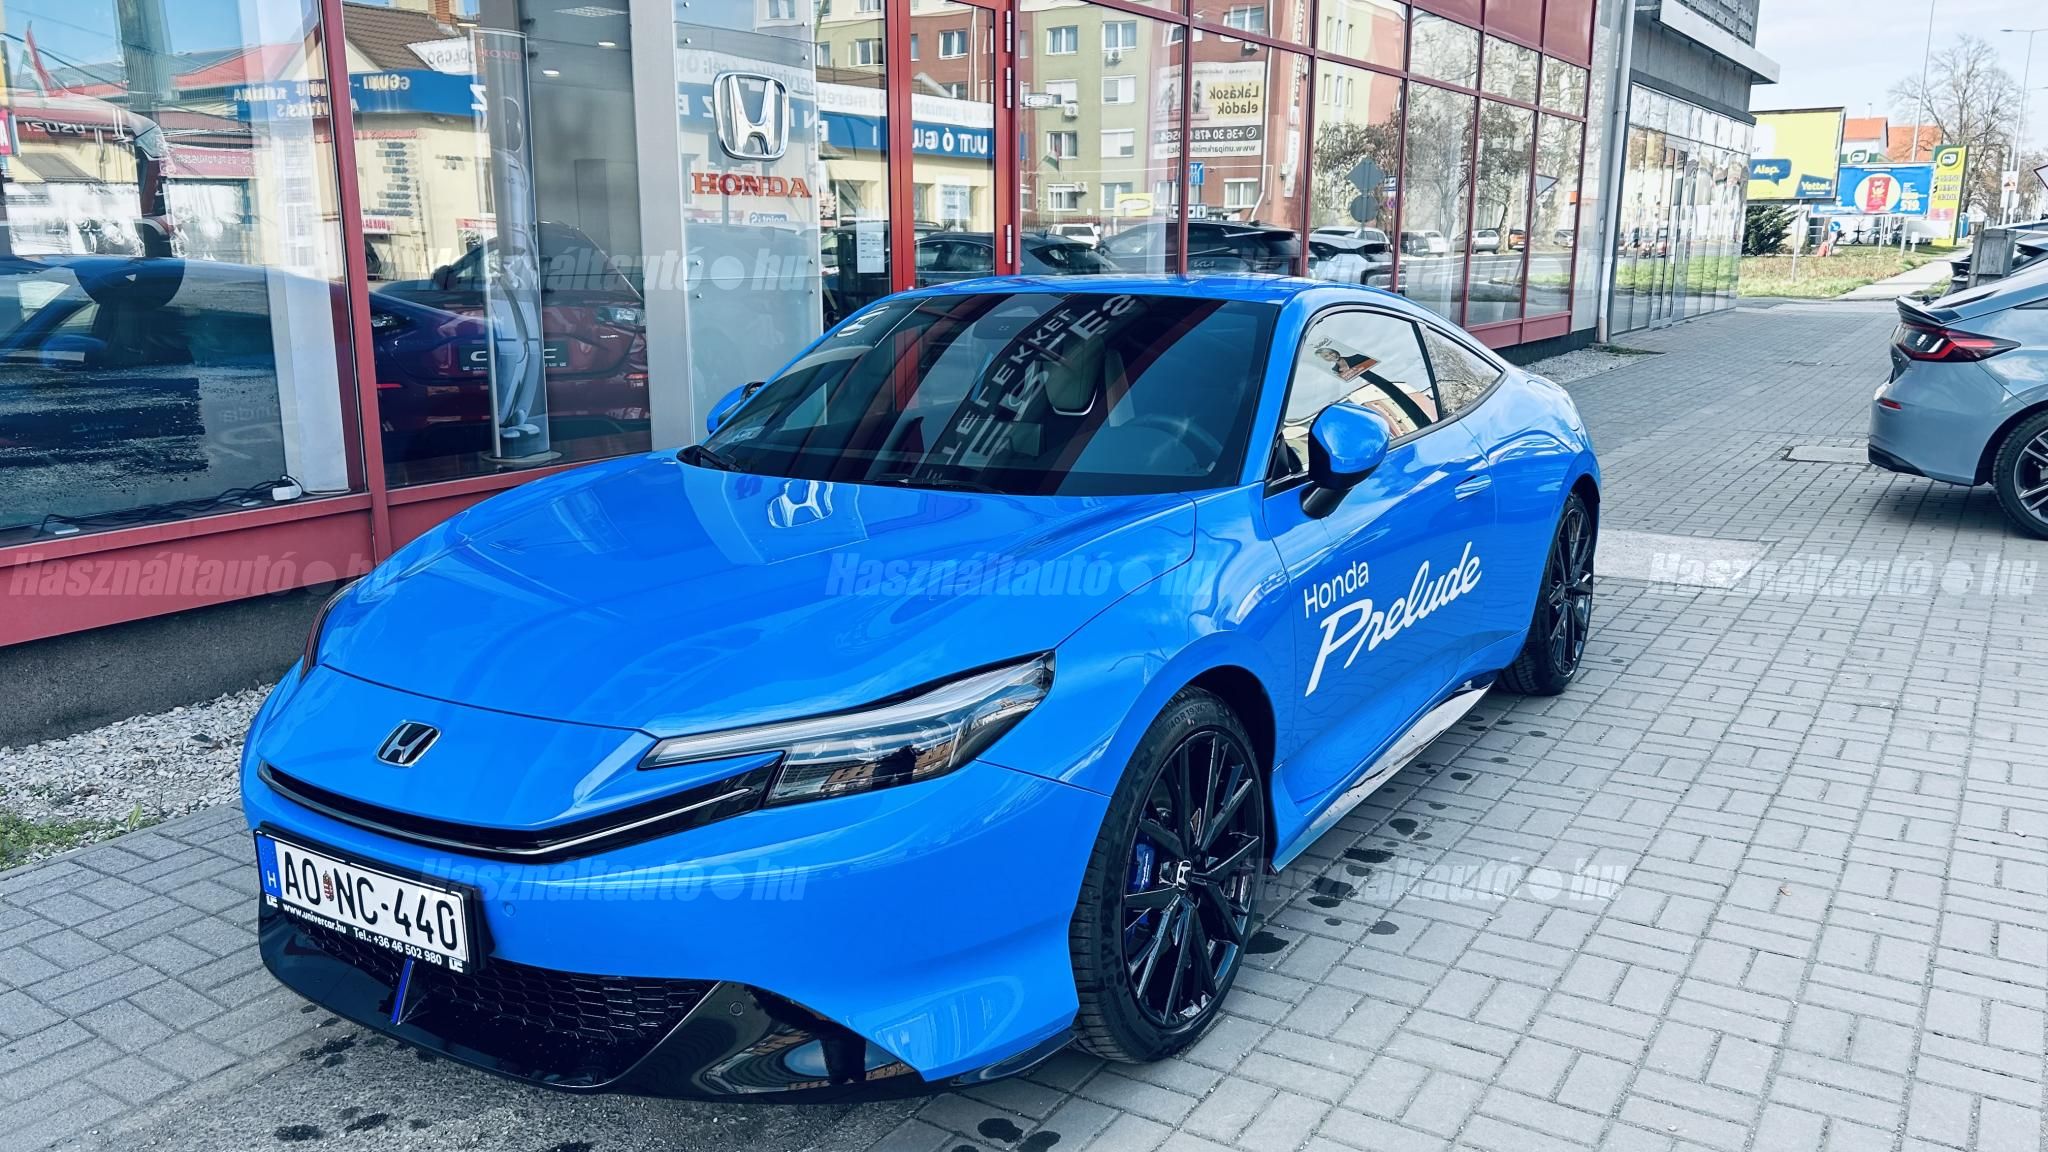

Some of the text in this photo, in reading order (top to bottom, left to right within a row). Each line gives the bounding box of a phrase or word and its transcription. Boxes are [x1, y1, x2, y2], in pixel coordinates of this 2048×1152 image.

[24, 121, 86, 134] ISUZU
[691, 172, 812, 198] HONDA
[1303, 560, 1370, 619] Honda
[1304, 540, 1483, 697] Prelude
[266, 870, 278, 889] H
[284, 851, 458, 951] AO NC-440
[282, 902, 347, 935] www.univercar.hu
[353, 927, 373, 943] Tel.:
[373, 935, 390, 949] +36
[391, 941, 404, 953] 46
[405, 944, 423, 959] 502
[424, 950, 443, 966] 980
